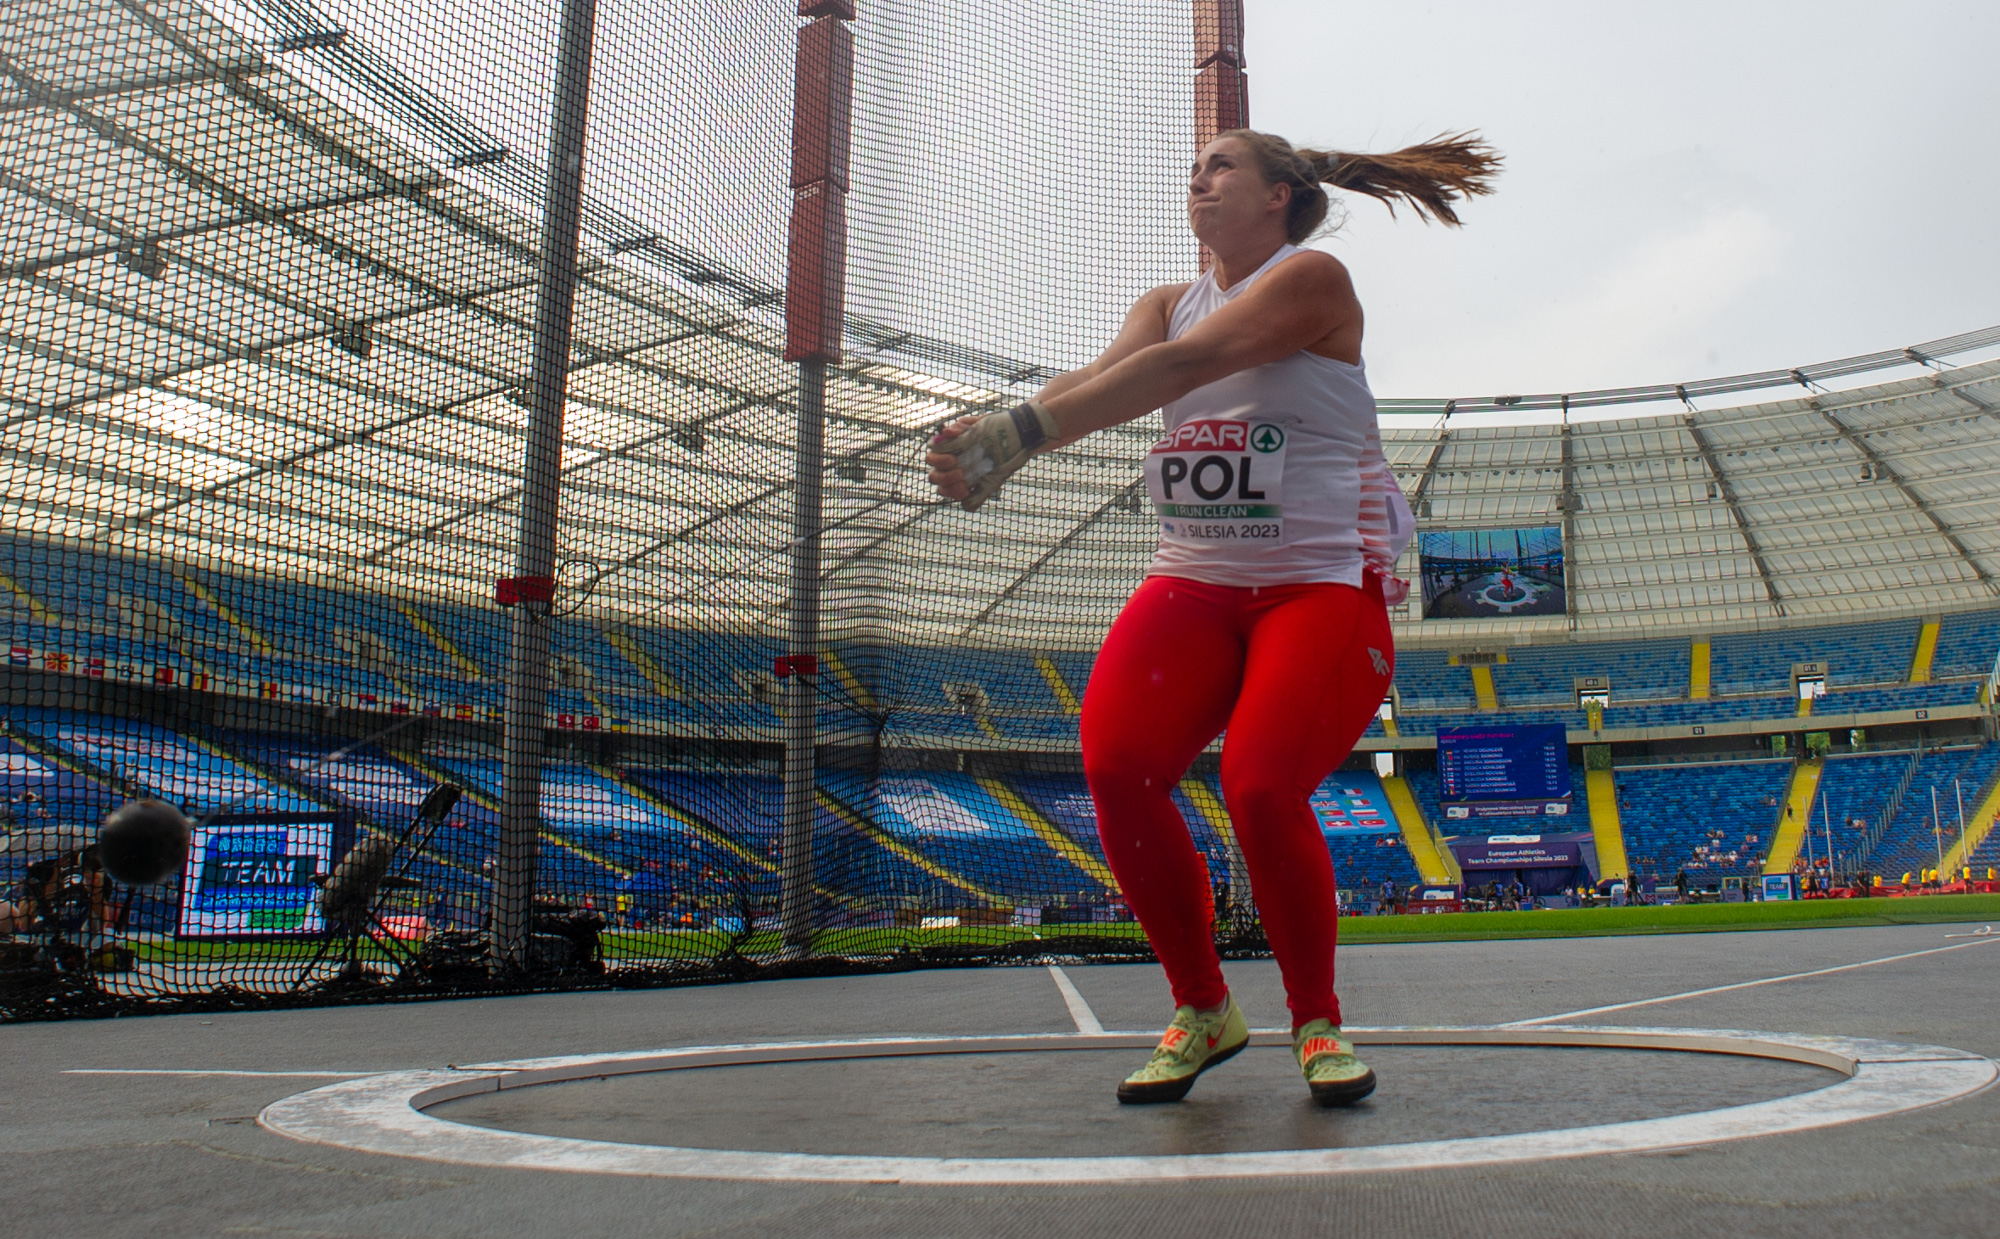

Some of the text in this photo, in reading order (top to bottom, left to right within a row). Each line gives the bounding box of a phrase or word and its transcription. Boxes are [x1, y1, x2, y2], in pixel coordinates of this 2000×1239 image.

[1161, 455, 1266, 501] POL
[1174, 505, 1247, 518] I RUN CLEAN
[1188, 524, 1280, 538] SILESIA 2023
[222, 859, 297, 884] TEAM
[1302, 1036, 1341, 1063] NIKE
